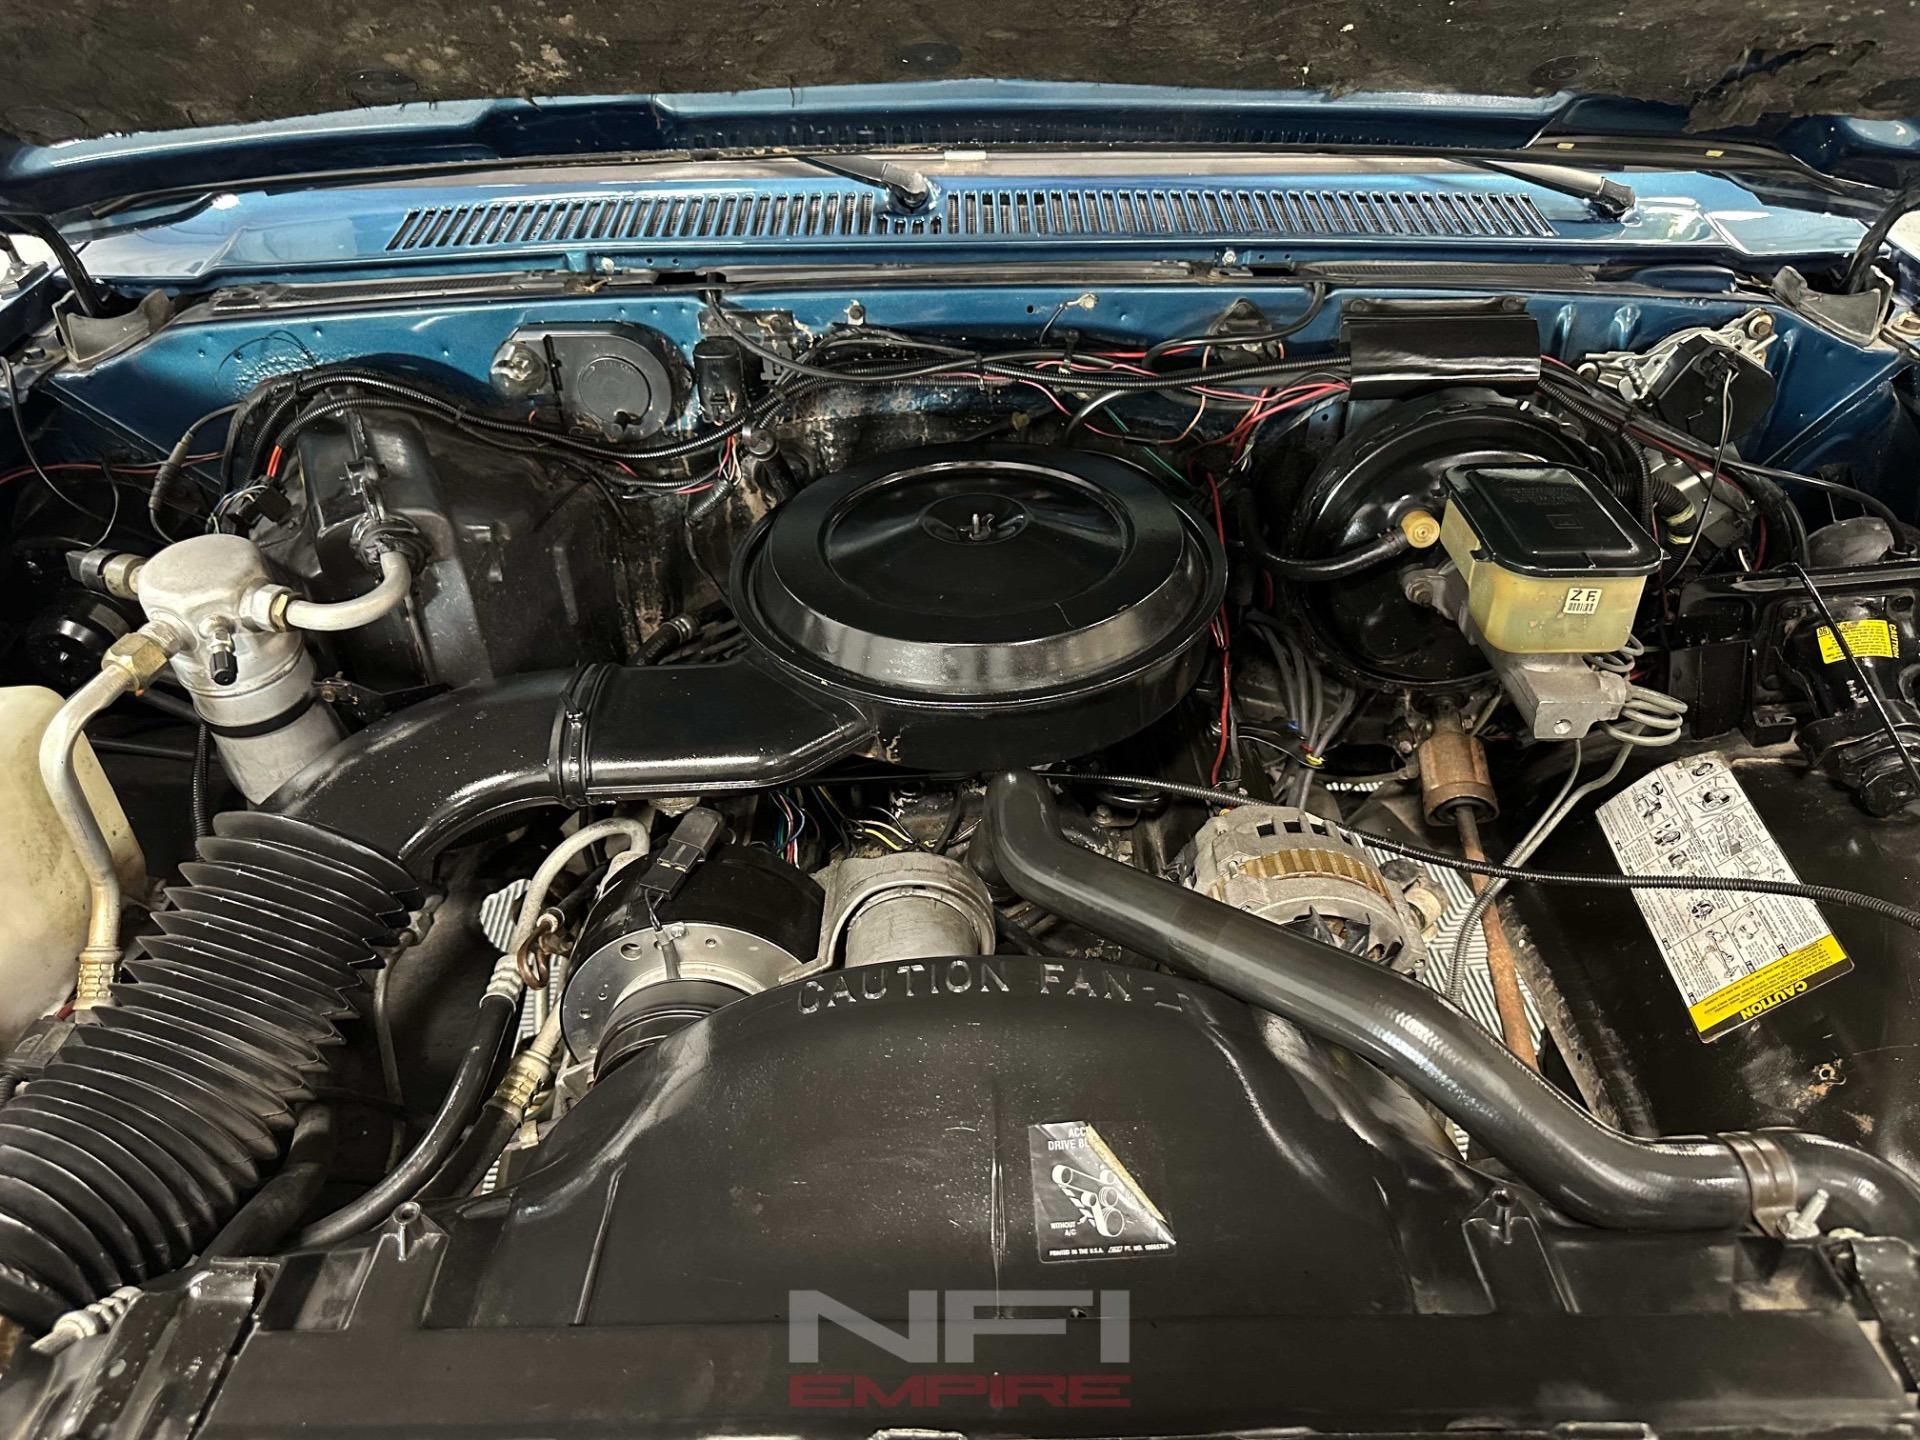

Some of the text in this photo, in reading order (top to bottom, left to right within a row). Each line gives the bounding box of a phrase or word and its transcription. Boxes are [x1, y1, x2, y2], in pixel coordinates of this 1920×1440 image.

[1888, 623, 1900, 659] CAUTION
[797, 960, 1010, 1014] CAUTION
[1739, 980, 1808, 1020] CAUTION
[1048, 1140, 1076, 1151] DRIVE
[1068, 1126, 1089, 1138] ACC
